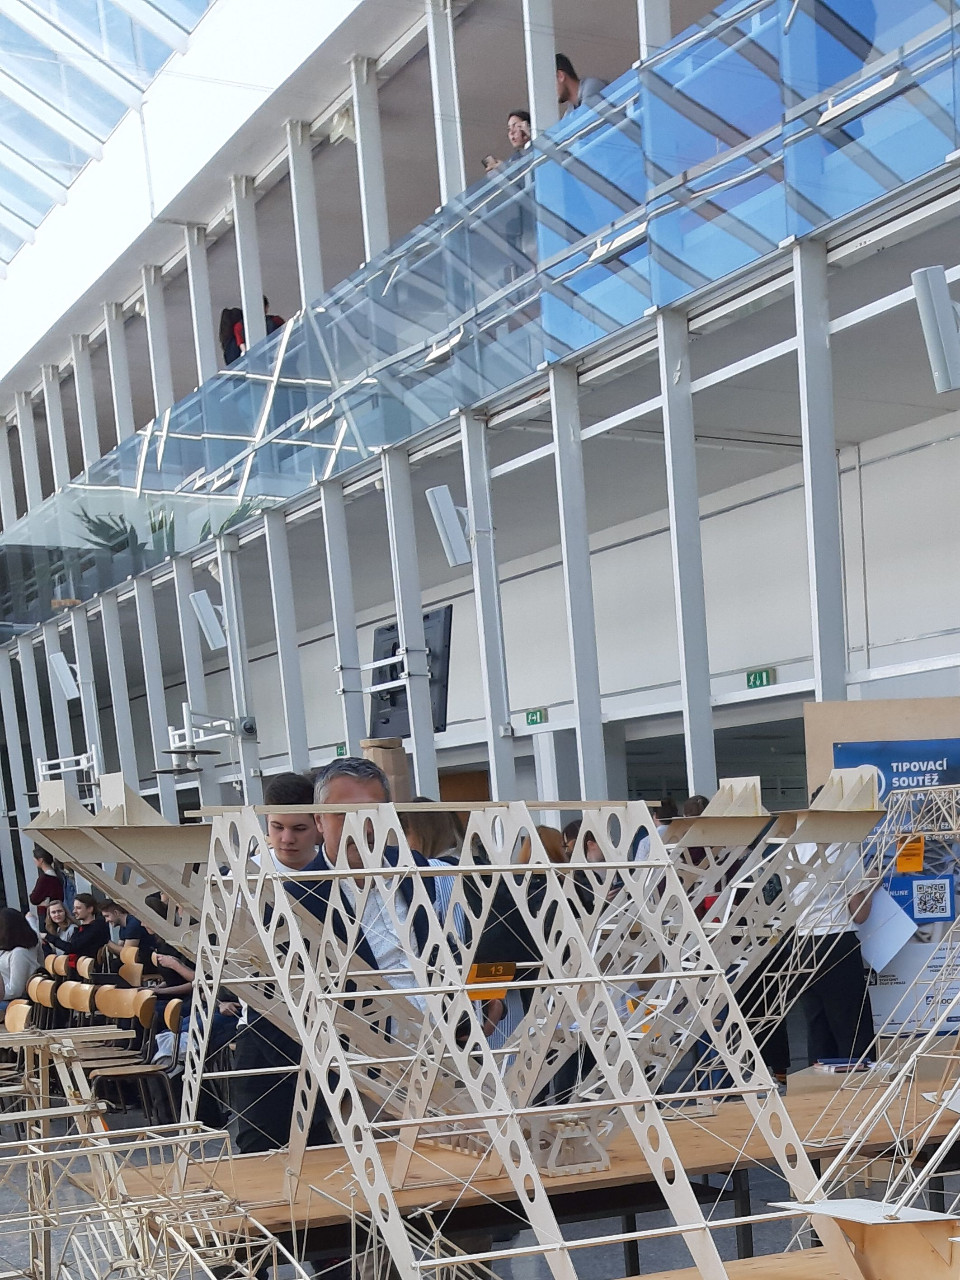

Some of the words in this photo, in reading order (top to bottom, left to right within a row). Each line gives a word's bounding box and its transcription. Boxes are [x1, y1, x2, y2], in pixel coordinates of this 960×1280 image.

[891, 758, 948, 773] TIPOVACÍ
[892, 772, 940, 787] SOUTĚŽ
[490, 965, 504, 975] 13
